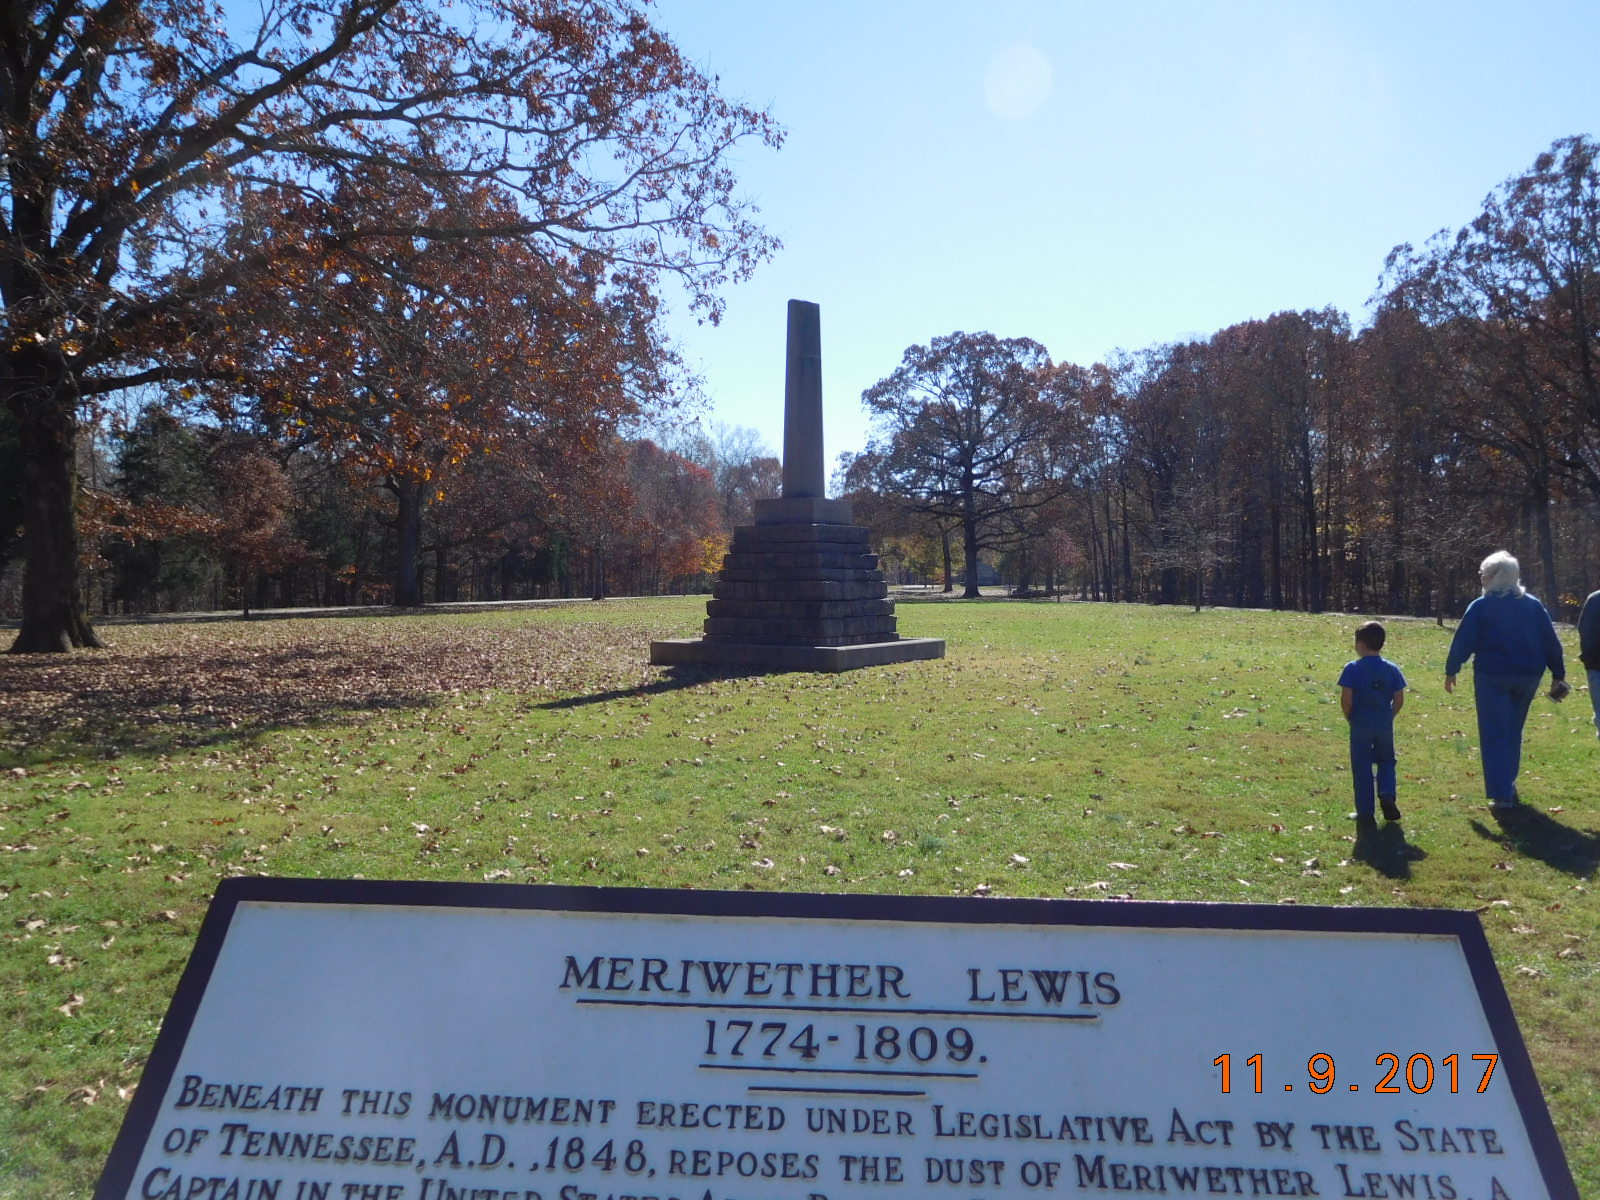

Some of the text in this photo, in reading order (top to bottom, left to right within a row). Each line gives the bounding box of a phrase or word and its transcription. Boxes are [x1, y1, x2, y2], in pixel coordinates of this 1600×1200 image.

[559, 956, 1120, 1005] MERIWETHER LEWIS
[175, 1075, 1504, 1154] BENEATH THIS MONUMENT ERECTED UNDER LEGISLATIVE ACT BY THE STATE
[145, 1168, 282, 1200] CAPTAIN
[164, 1128, 209, 1153] OF
[220, 1123, 425, 1169] TENNESSEE,
[669, 1150, 819, 1179] REPOSES
[839, 1155, 903, 1184] THE
[925, 1157, 1004, 1186] DUST
[1021, 1161, 1060, 1188] OF
[1074, 1154, 1320, 1197] MERIWETHER
[1336, 1164, 1473, 1200] LEWIS
